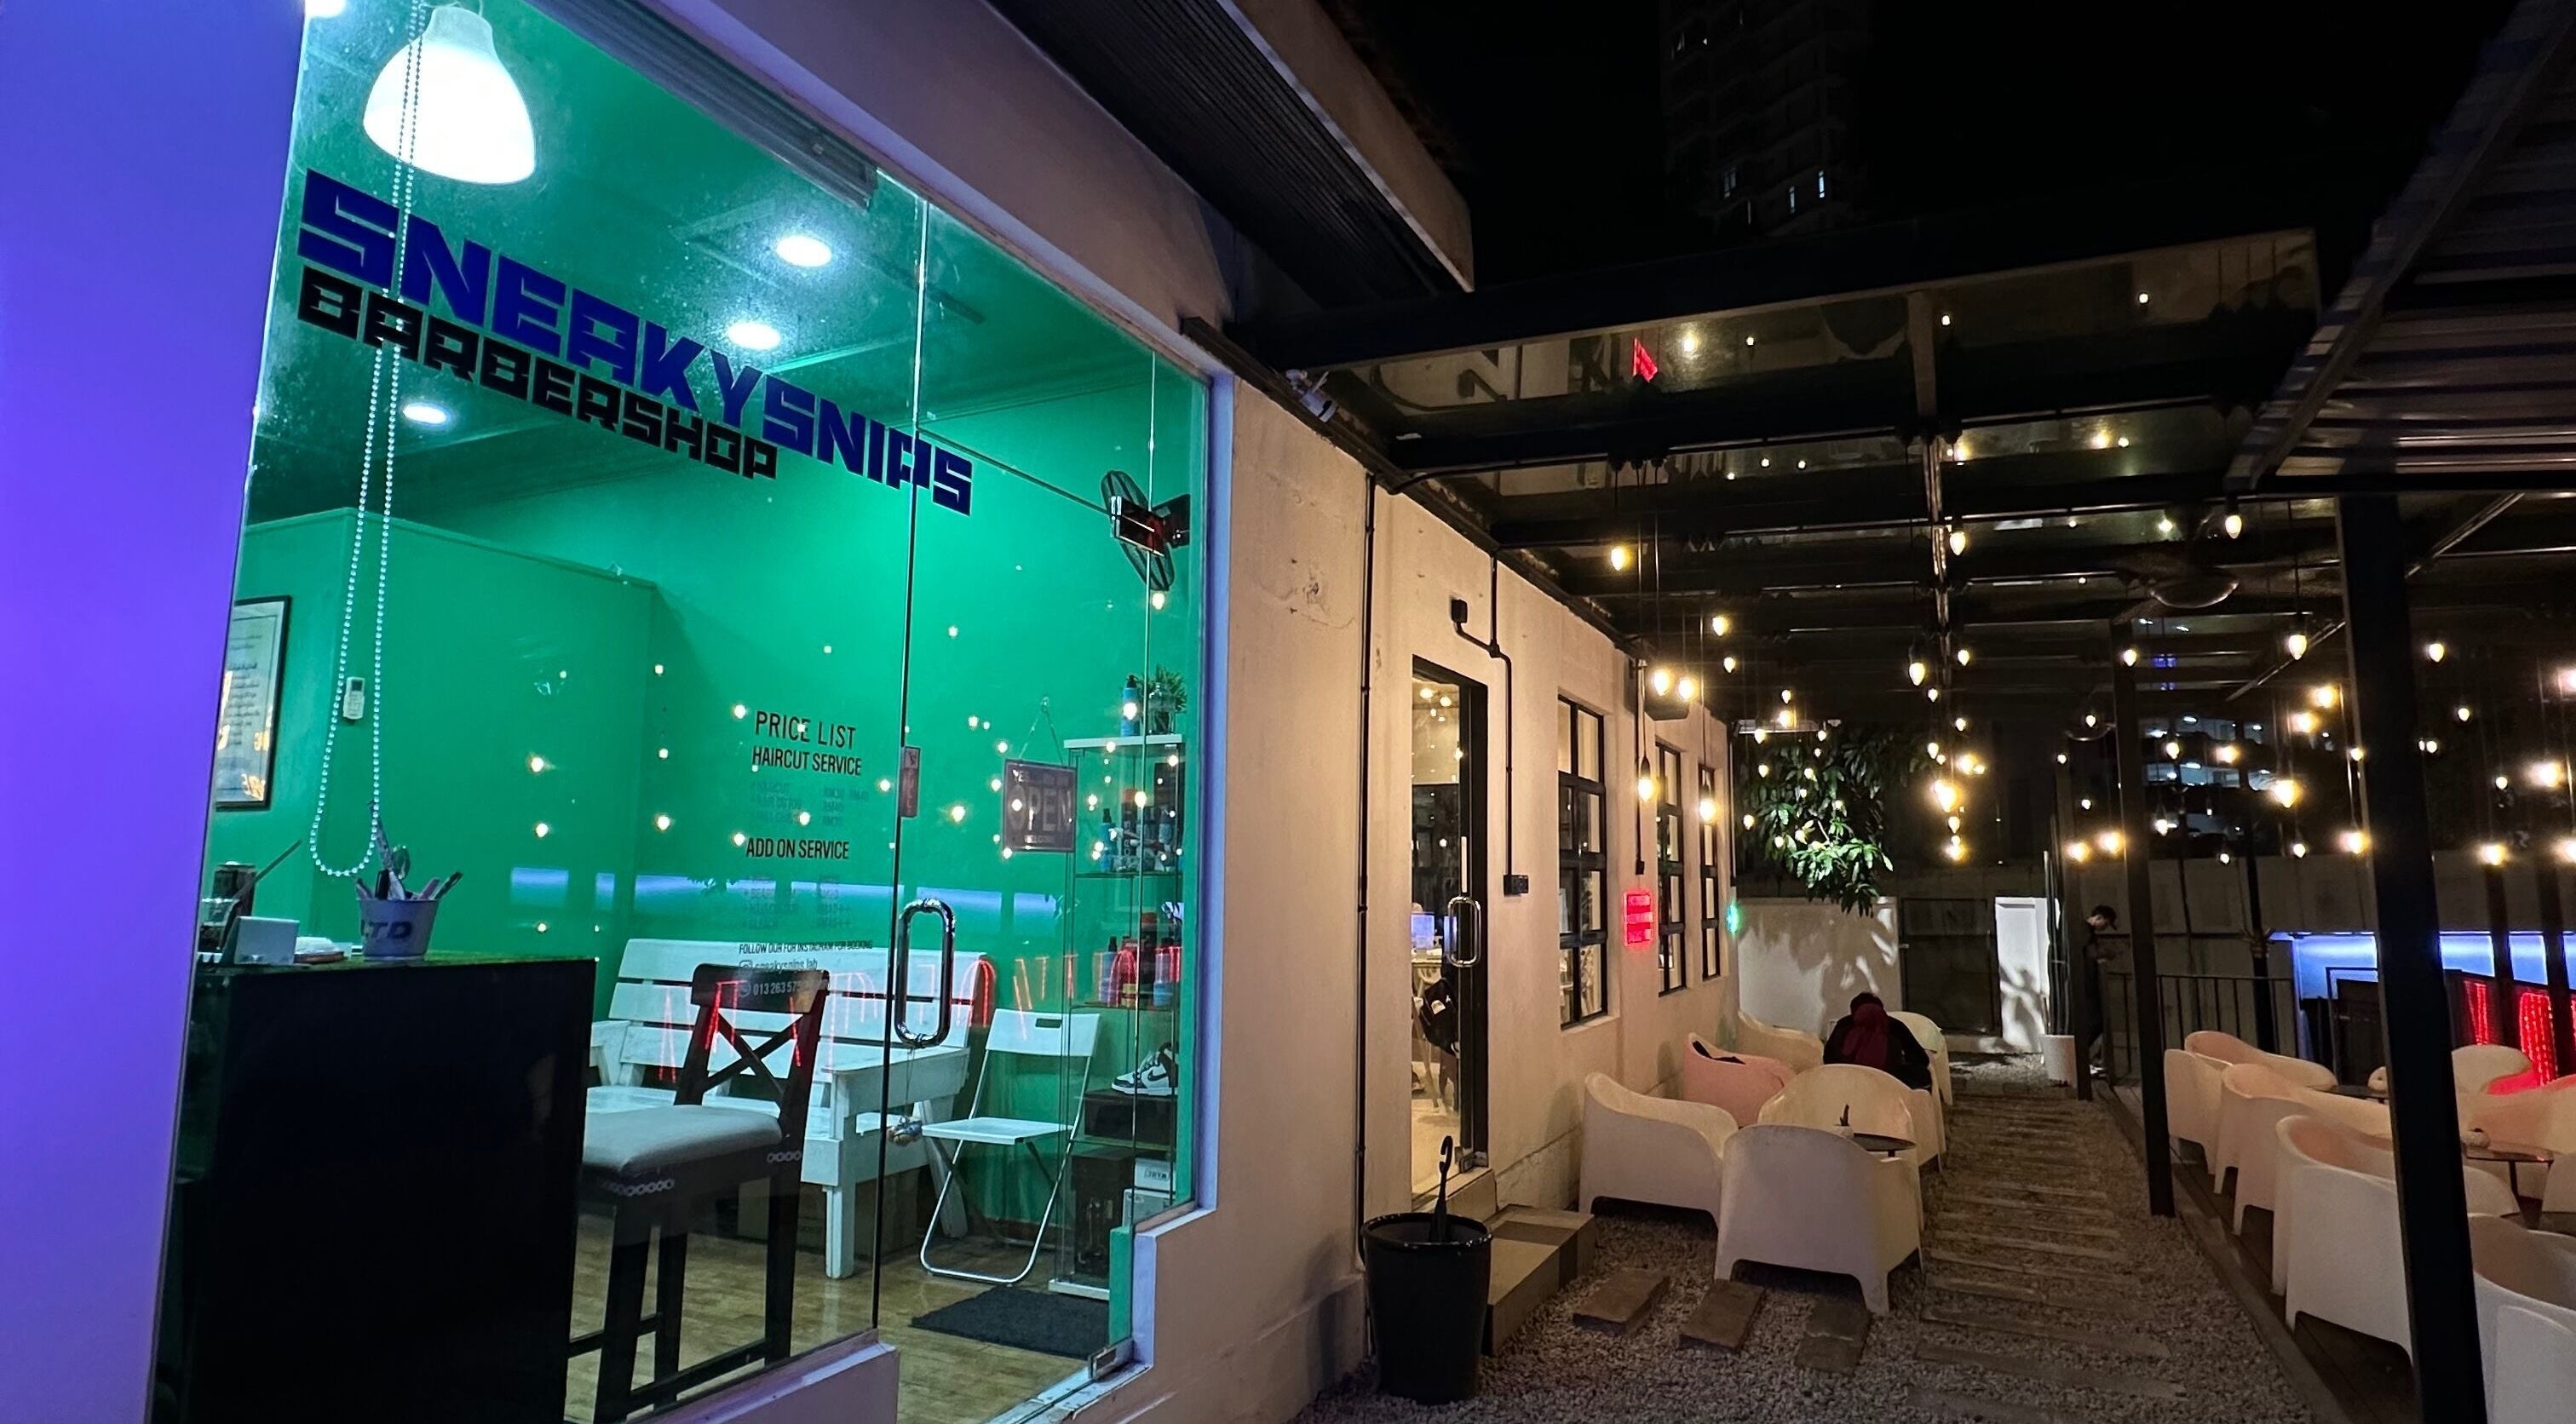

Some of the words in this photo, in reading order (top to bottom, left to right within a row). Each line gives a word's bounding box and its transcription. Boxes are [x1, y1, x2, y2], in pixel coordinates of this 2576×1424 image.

[297, 168, 972, 516] SNEAKYSNIPS
[297, 265, 777, 479] BARBERSHOP
[755, 710, 811, 743] PRICE
[818, 721, 857, 749] LIST
[752, 745, 810, 770] HAIRCUT
[812, 752, 862, 776] SERVICE
[1007, 784, 1072, 832] OPEN
[746, 837, 774, 858] ADD
[776, 838, 796, 858] ON
[798, 839, 849, 859] SERVICE
[739, 943, 767, 955] FOLLOW
